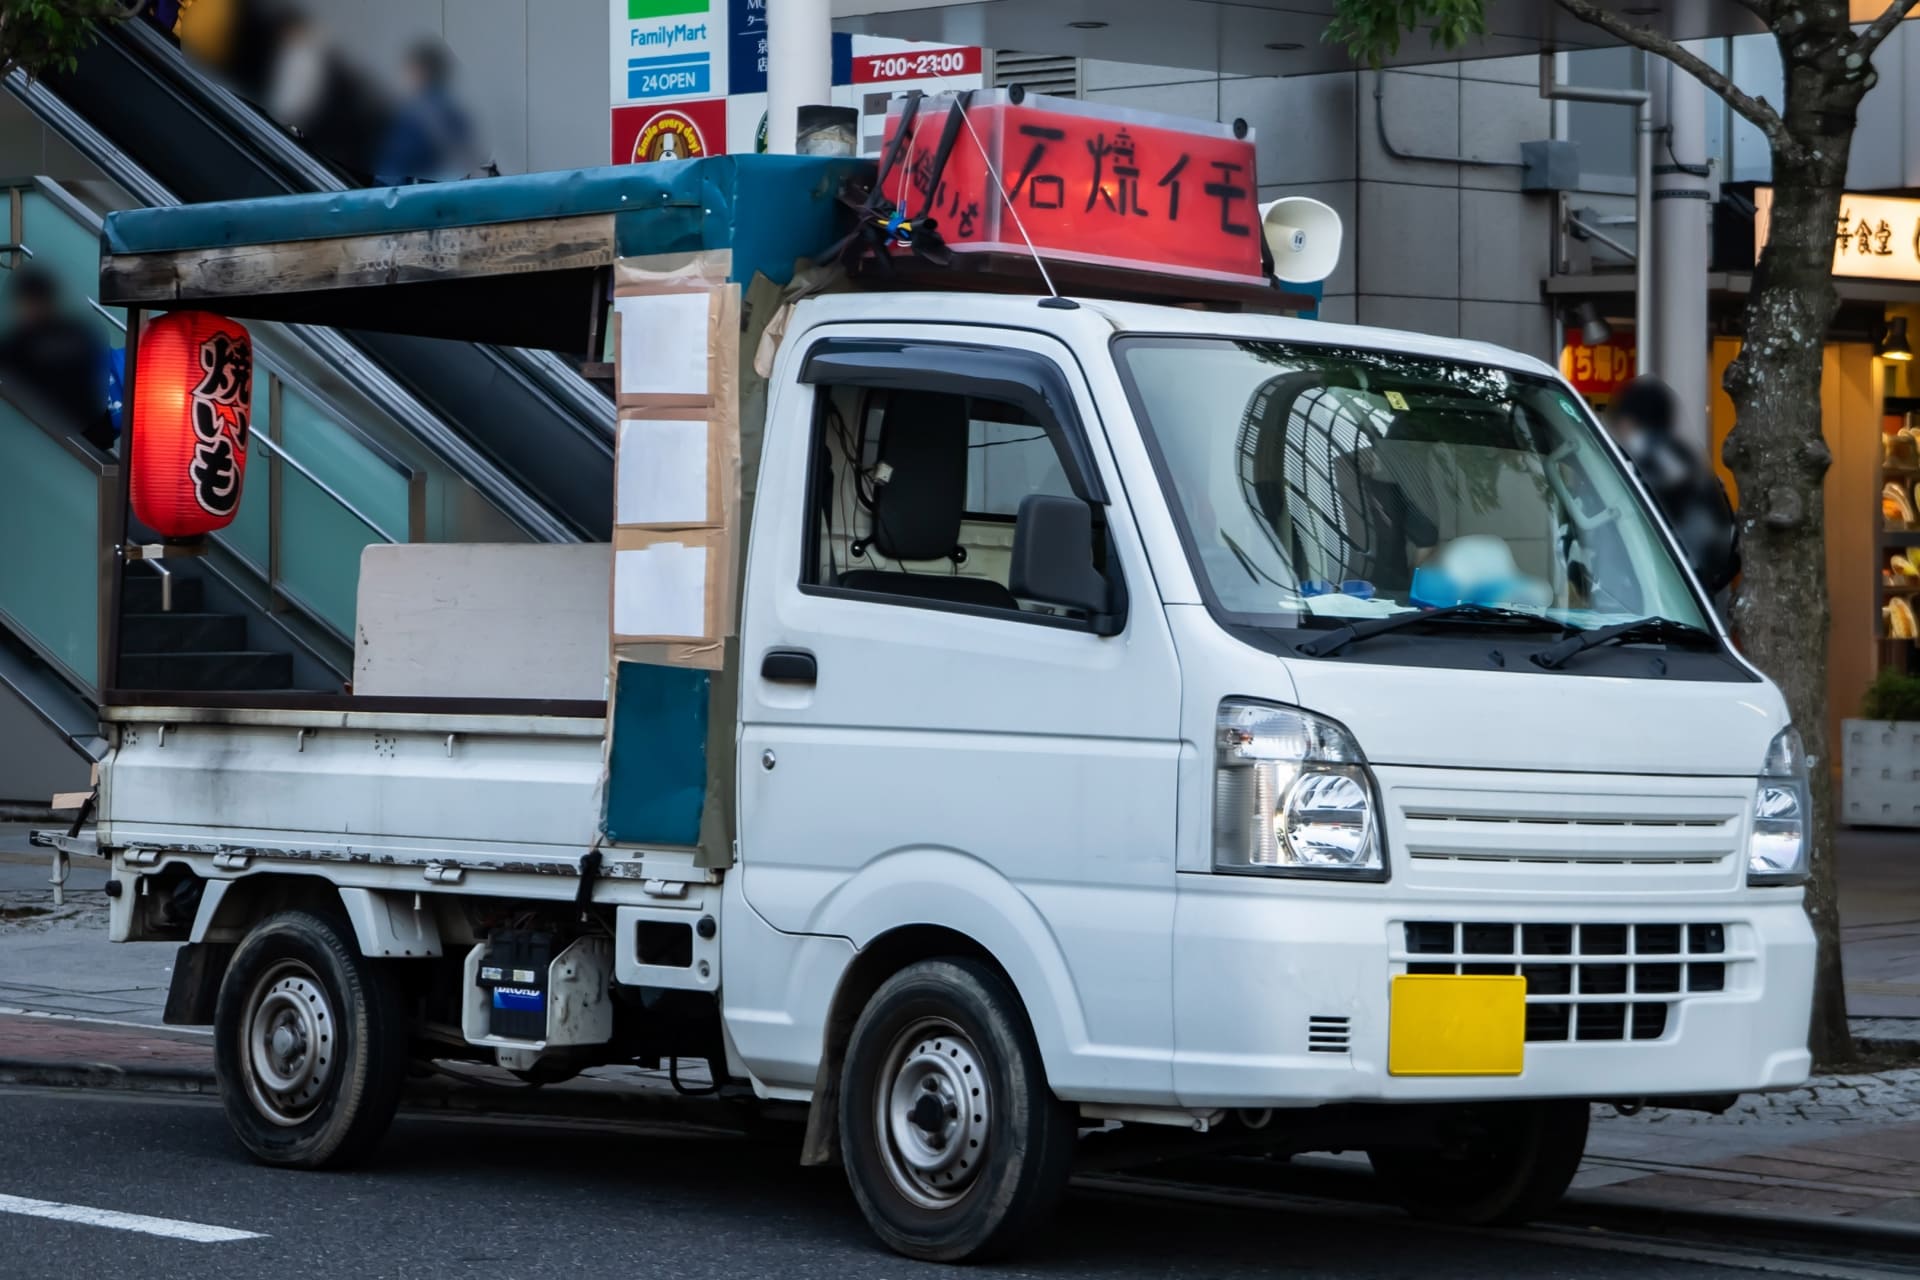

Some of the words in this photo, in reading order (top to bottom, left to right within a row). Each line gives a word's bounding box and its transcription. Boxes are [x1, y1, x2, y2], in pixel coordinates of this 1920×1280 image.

[630, 24, 707, 48] FamilyMart
[658, 118, 685, 134] every
[1005, 125, 1251, 237] 石焼イモ
[190, 331, 252, 517] 焼いも
